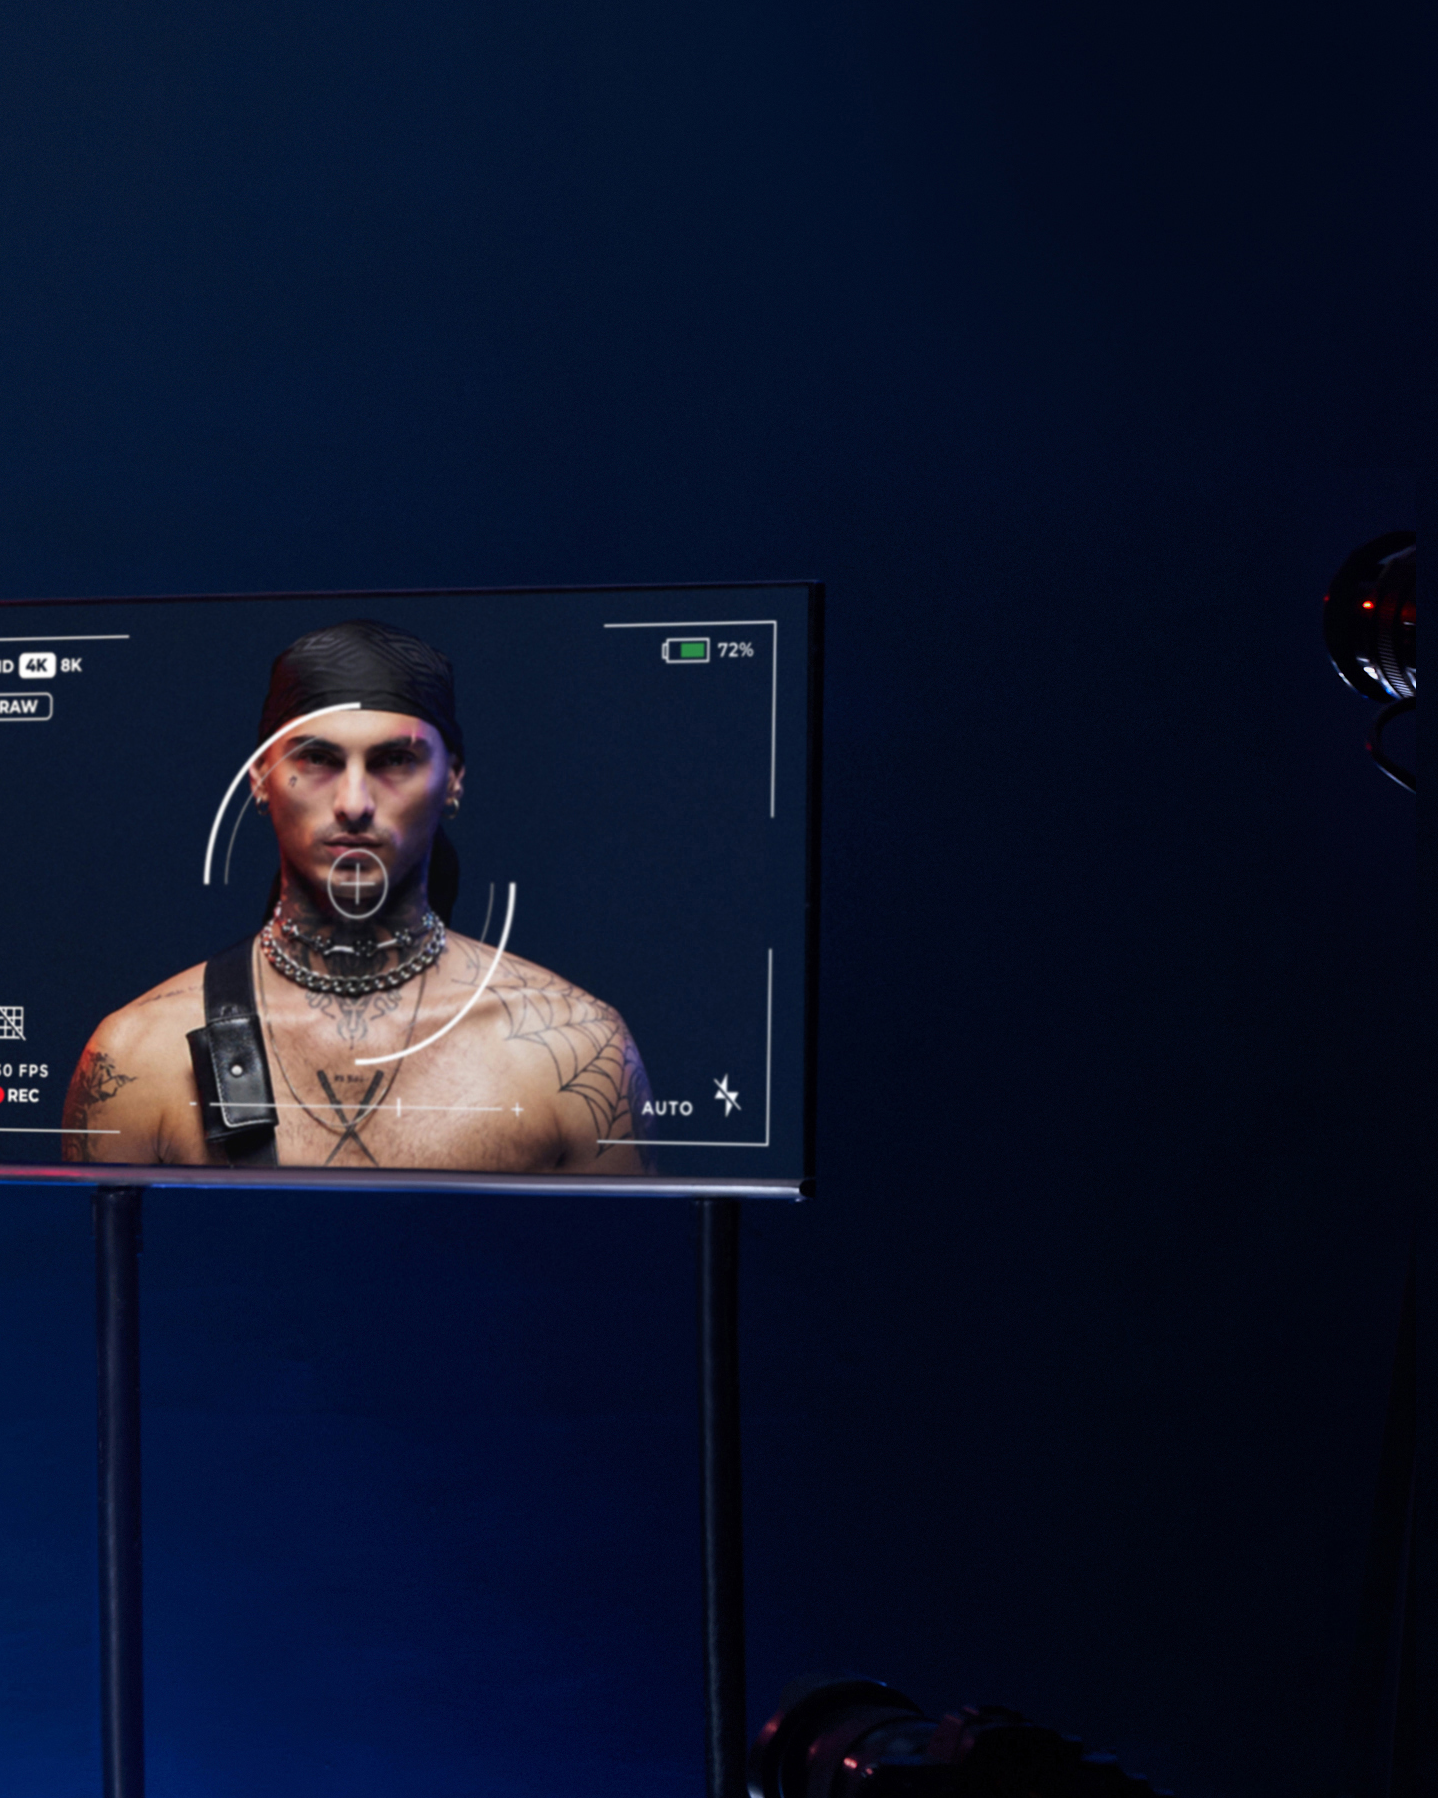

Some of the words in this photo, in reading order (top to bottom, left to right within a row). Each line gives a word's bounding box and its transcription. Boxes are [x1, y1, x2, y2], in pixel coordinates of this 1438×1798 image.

[717, 642, 754, 658] 72%
[25, 658, 48, 673] 4K
[60, 657, 83, 673] 8K
[19, 1063, 49, 1078] FPS
[7, 1088, 40, 1103] REC
[641, 1100, 694, 1116] AUTO
